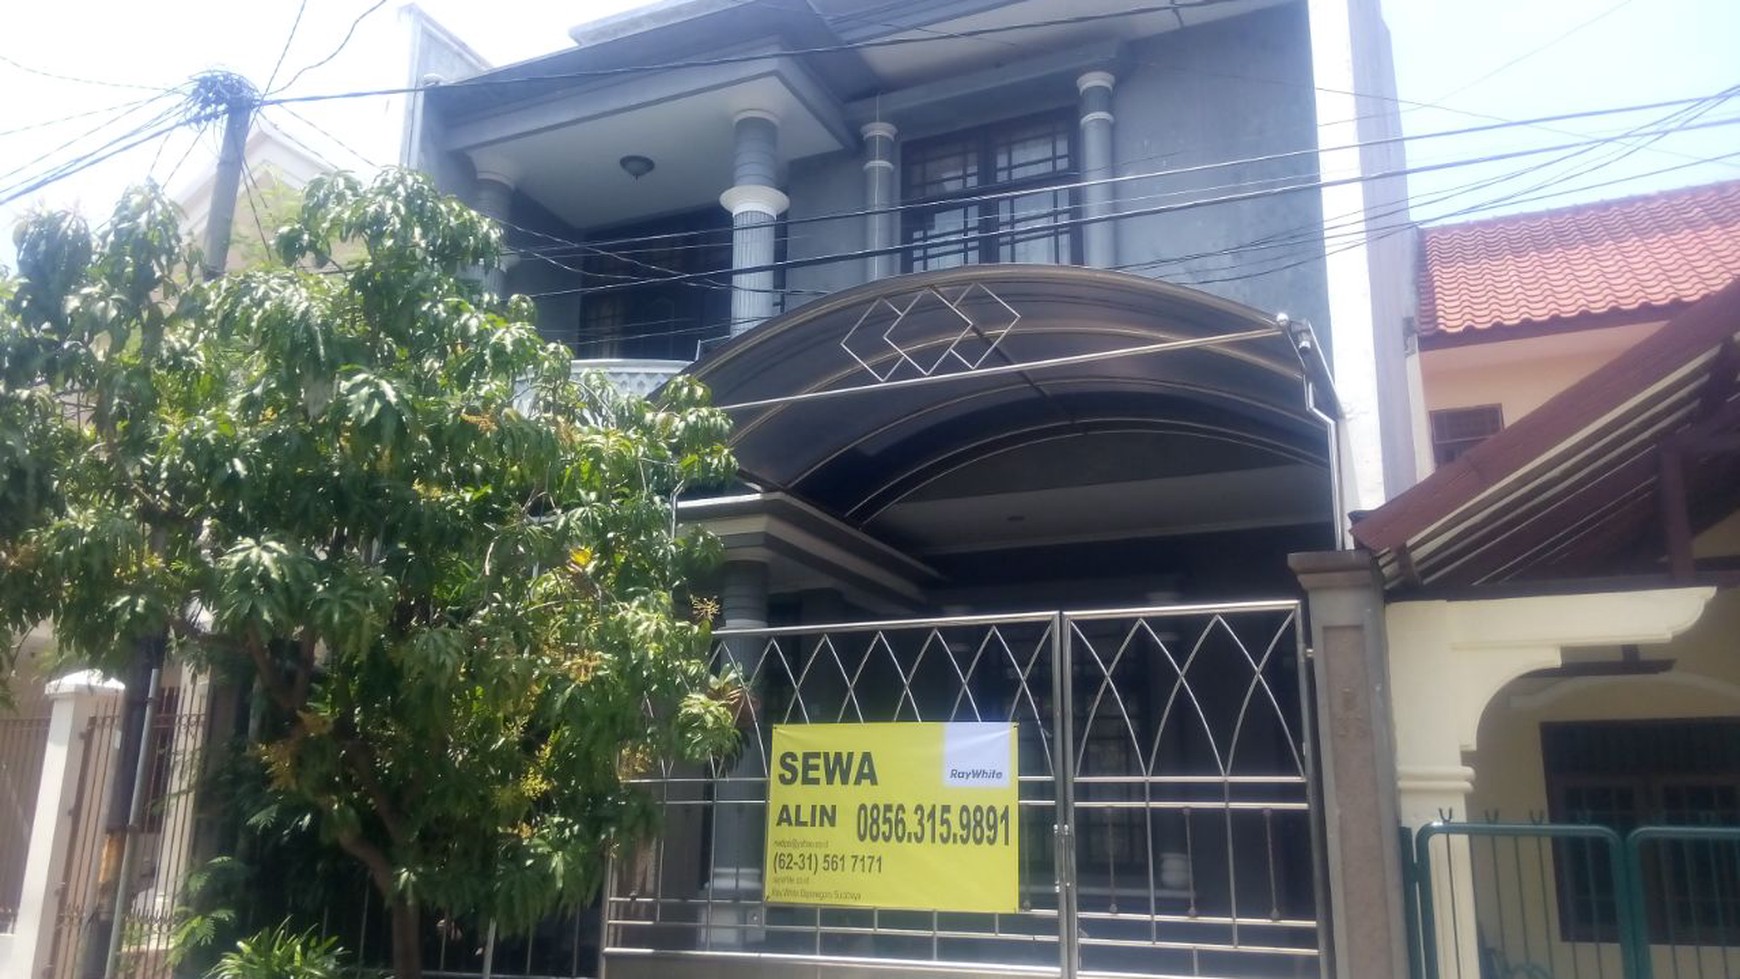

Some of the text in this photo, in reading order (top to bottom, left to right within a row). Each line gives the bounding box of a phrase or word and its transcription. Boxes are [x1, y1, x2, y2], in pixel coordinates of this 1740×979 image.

[778, 751, 878, 786] SEWA
[775, 804, 837, 827] ALIN
[856, 802, 1010, 846] 0856.315.9891
[773, 851, 882, 875] (62-31) 561 7171
